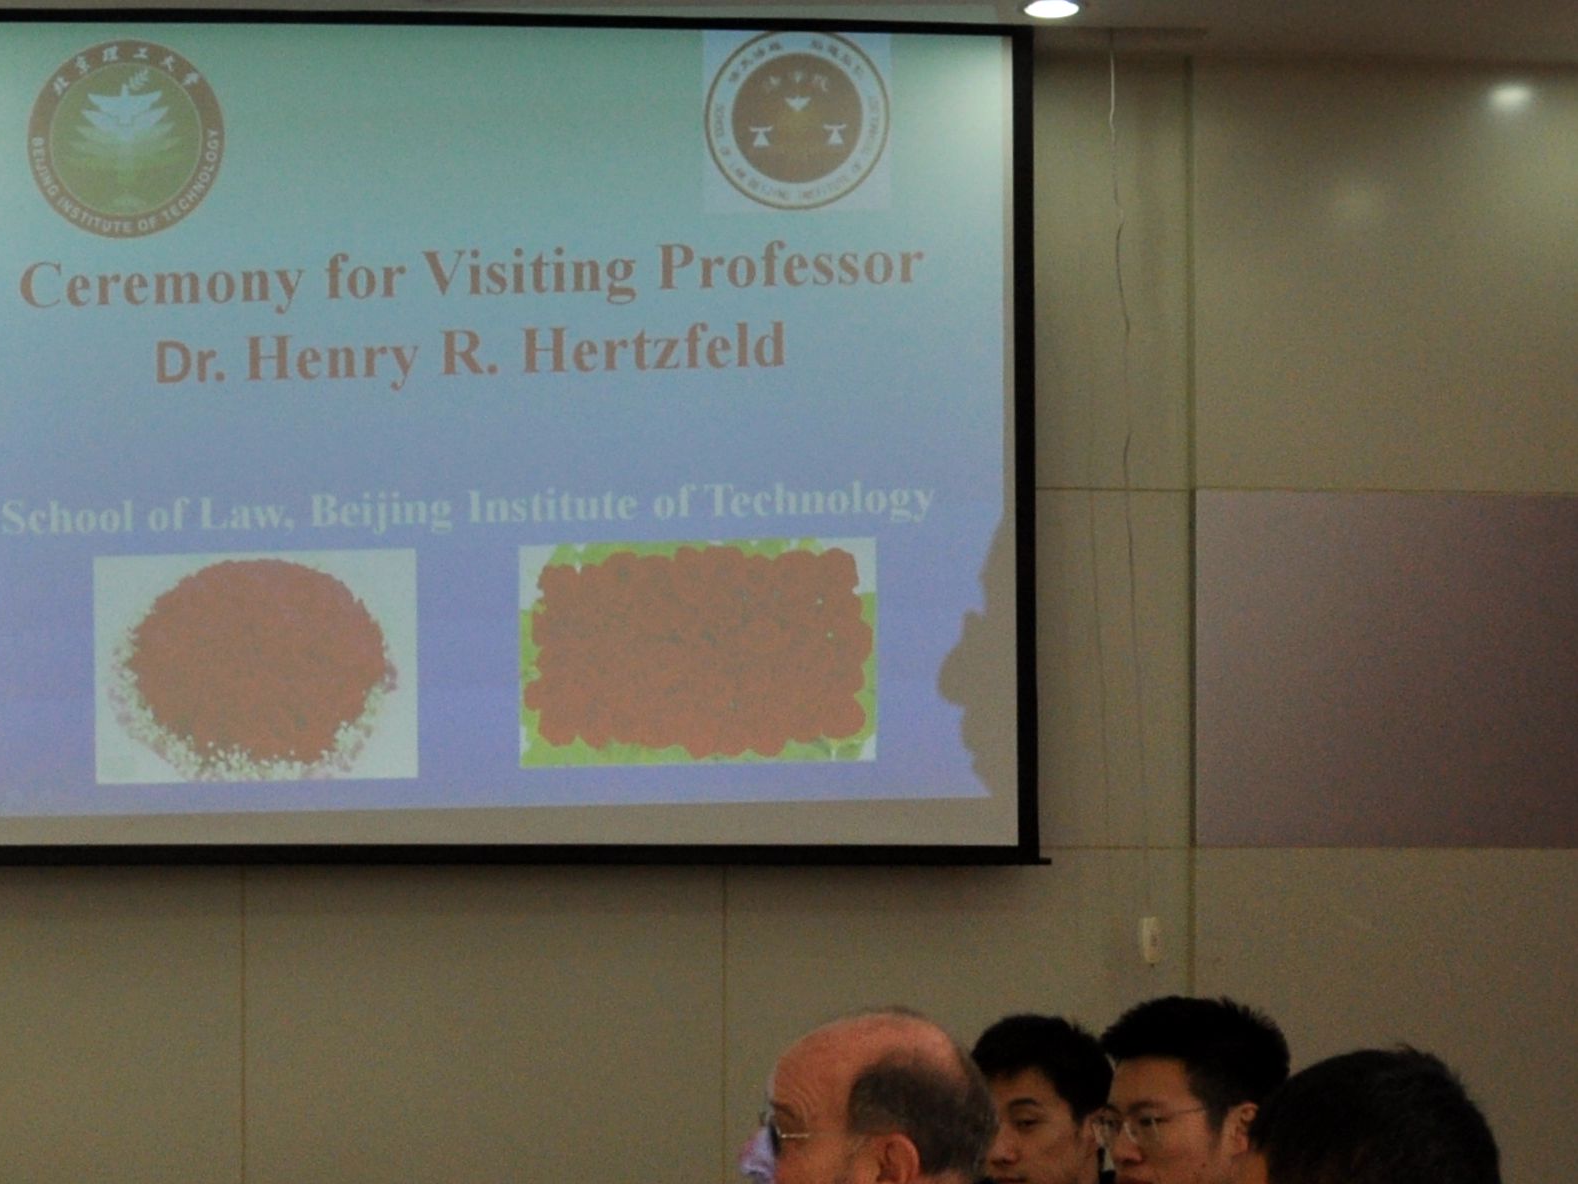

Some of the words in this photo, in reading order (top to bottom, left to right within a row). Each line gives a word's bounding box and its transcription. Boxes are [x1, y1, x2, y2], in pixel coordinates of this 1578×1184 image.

[31, 136, 60, 196] BEIJING
[56, 196, 134, 233] INSTITUTE
[137, 215, 159, 232] OF
[161, 128, 220, 222] TECHNOLOGY
[20, 260, 305, 314] Ceremony
[325, 252, 406, 300] for
[422, 246, 636, 305] Visiting
[657, 240, 924, 290] Professor
[156, 339, 225, 384] Dr.
[245, 333, 418, 391] Henry
[439, 329, 499, 376] R.
[522, 320, 785, 374] Hertzfeld
[0, 499, 134, 536] School
[147, 497, 190, 532] of
[200, 496, 295, 533] Law,
[311, 491, 452, 534] Beijing
[468, 487, 638, 523] Institute
[653, 483, 697, 520] of
[703, 480, 935, 524] Technology
